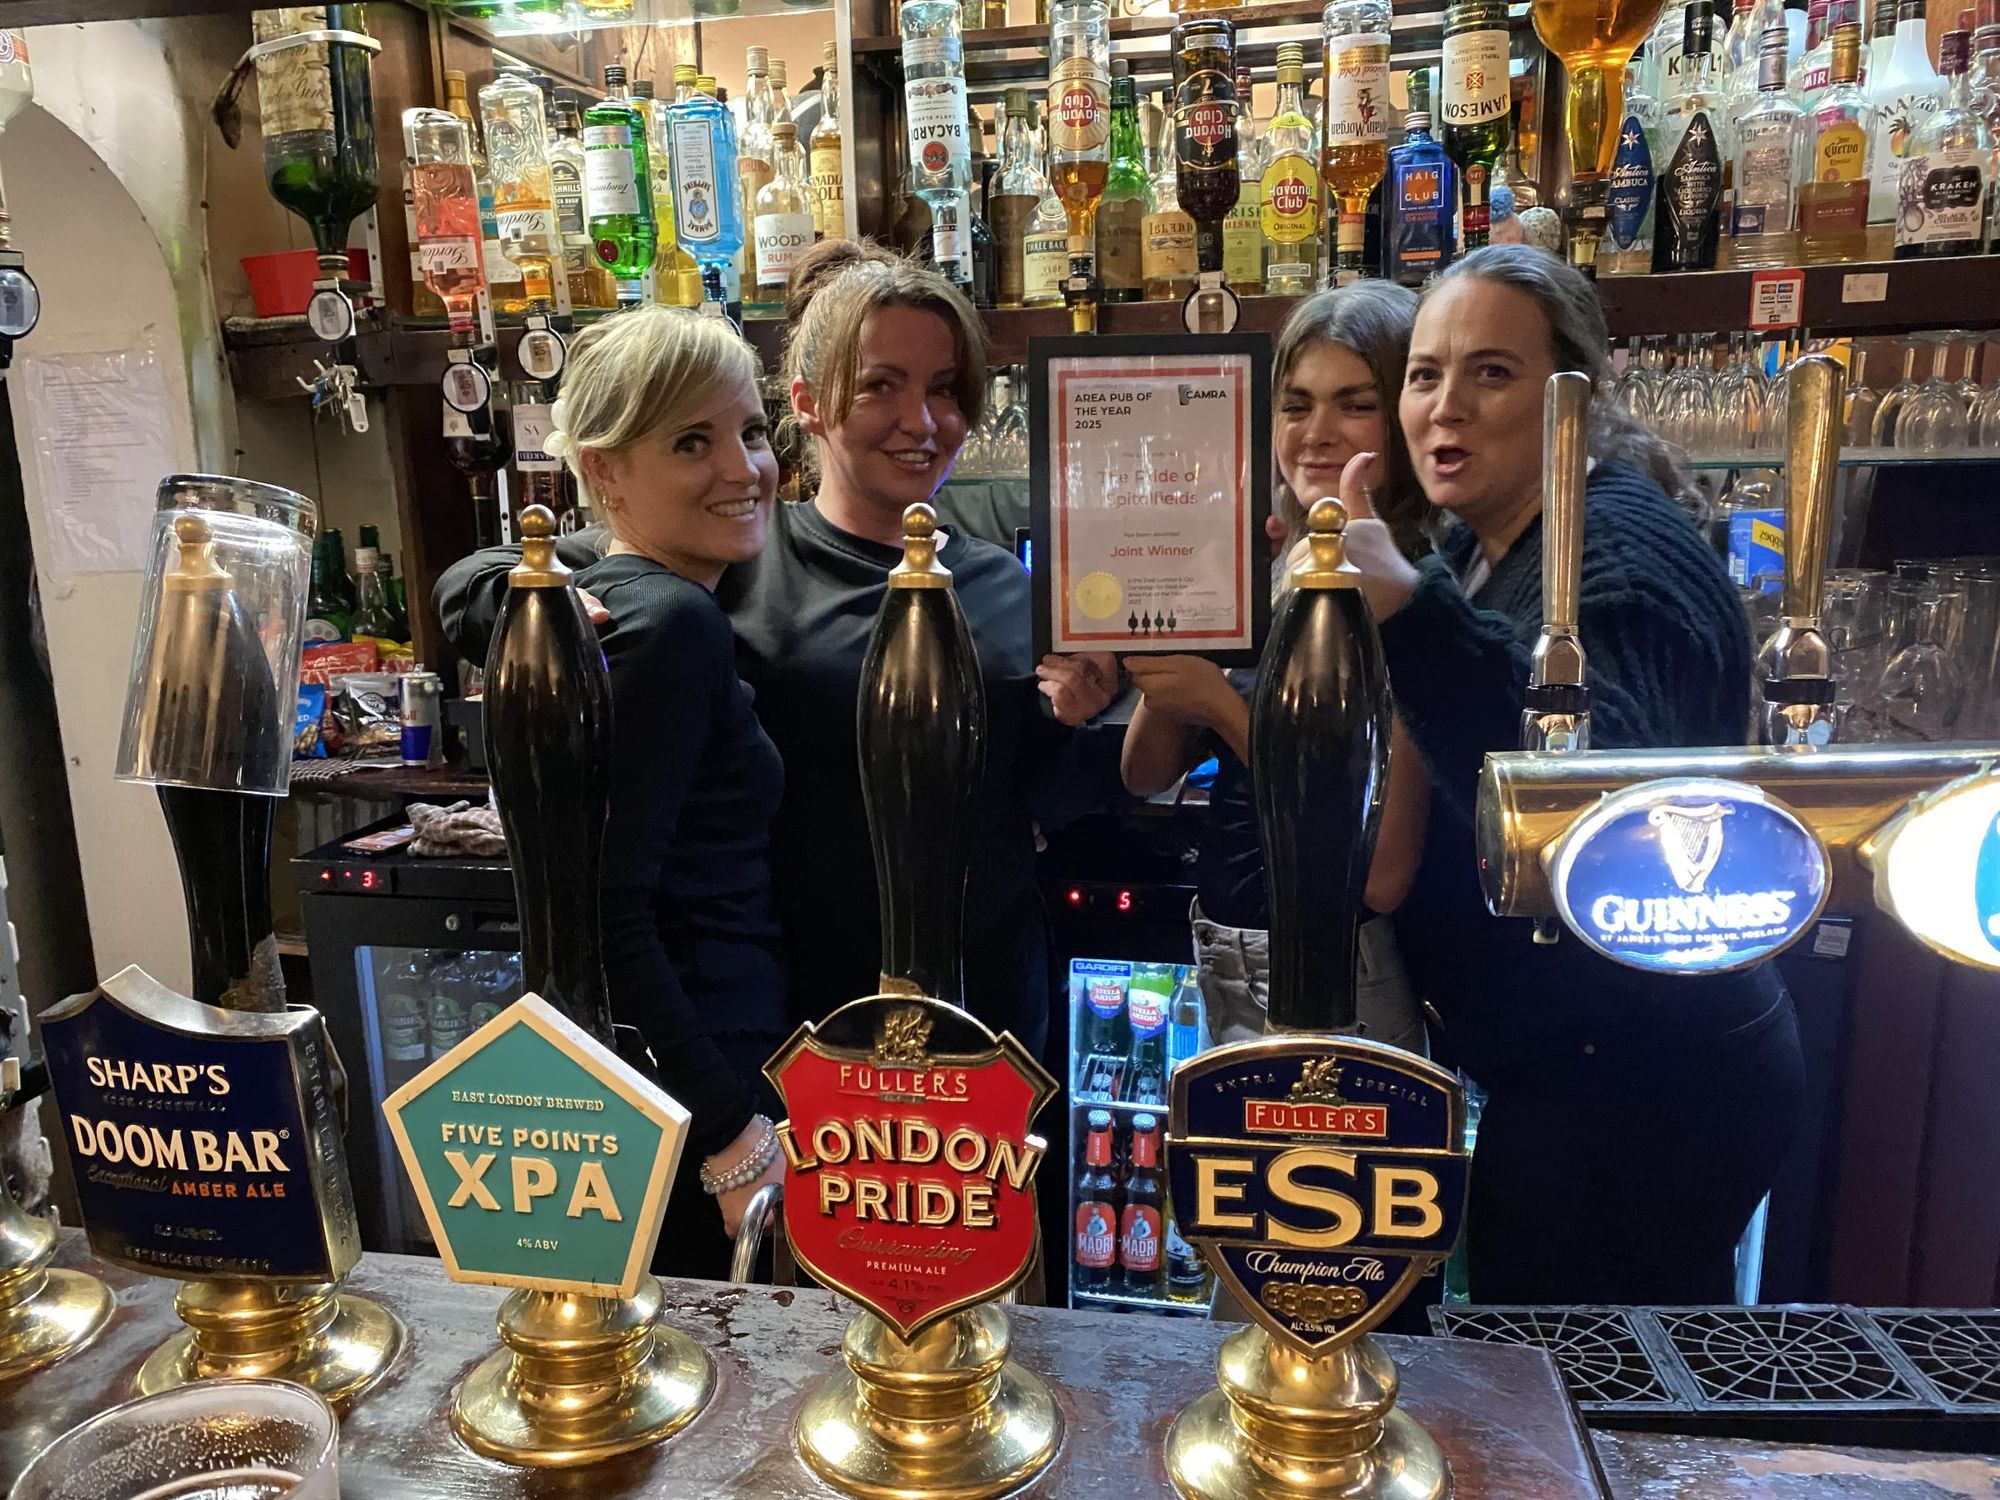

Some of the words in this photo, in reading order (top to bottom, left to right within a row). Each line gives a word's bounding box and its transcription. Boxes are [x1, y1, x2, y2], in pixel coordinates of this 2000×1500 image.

[1064, 94, 1092, 108] Club
[1444, 93, 1508, 119] JAMESON
[1056, 109, 1100, 124] Havana
[1194, 109, 1223, 123] Club
[1185, 124, 1232, 139] Havana
[1331, 120, 1365, 137] Morgan
[1824, 143, 1859, 158] Cuervo
[1674, 159, 1717, 176] Antica
[1405, 170, 1439, 182] HAIG
[554, 183, 581, 193] SHMILLS
[1268, 184, 1313, 197] Havana
[1611, 178, 1648, 190] AMBUCA
[1930, 181, 1977, 192] KRAKEN
[1276, 196, 1304, 210] Club
[1404, 191, 1439, 202] CLUB
[687, 219, 714, 233] BOMBAY
[767, 252, 793, 263] RUM
[1074, 392, 1106, 403] AREA
[1109, 392, 1133, 403] PUB
[1136, 391, 1153, 402] OF
[1185, 388, 1228, 400] CAMRA
[1075, 406, 1098, 416] THE
[1101, 406, 1132, 416] YEAR
[1074, 420, 1102, 430] 2025
[1110, 545, 1144, 558] Joint
[1147, 544, 1195, 557] Winner
[361, 870, 374, 889] 3
[1118, 891, 1131, 909] 5
[1591, 890, 1797, 934] GUINNESS
[1131, 1005, 1157, 1015] STELLA
[86, 1056, 231, 1096] SHARP'S
[1214, 1072, 1276, 1094] EXTRA
[1354, 1076, 1428, 1108] SPECIAL
[451, 1090, 485, 1104] EAST
[488, 1093, 543, 1107] LONDON
[546, 1096, 604, 1111] BREWED
[1255, 1106, 1378, 1132] FULLER'S
[70, 1114, 189, 1171] DOOM
[441, 1123, 503, 1147] FIVE
[513, 1128, 619, 1155] POINTS
[775, 1117, 1048, 1190] LONDON
[171, 1181, 238, 1198] AMBER
[246, 1182, 286, 1198] ALE
[444, 1150, 623, 1222] XPA
[819, 1172, 998, 1228] PRIDE
[1196, 1147, 1444, 1249] ESB
[516, 1237, 532, 1249] 4%
[534, 1239, 559, 1250] ABV
[866, 1260, 924, 1275] PREMIUM
[925, 1265, 948, 1276] ALE
[1245, 1250, 1340, 1284] Champion
[1342, 1256, 1386, 1282] Ale
[1290, 1321, 1304, 1331] ALC
[1323, 1324, 1337, 1334] VOL
